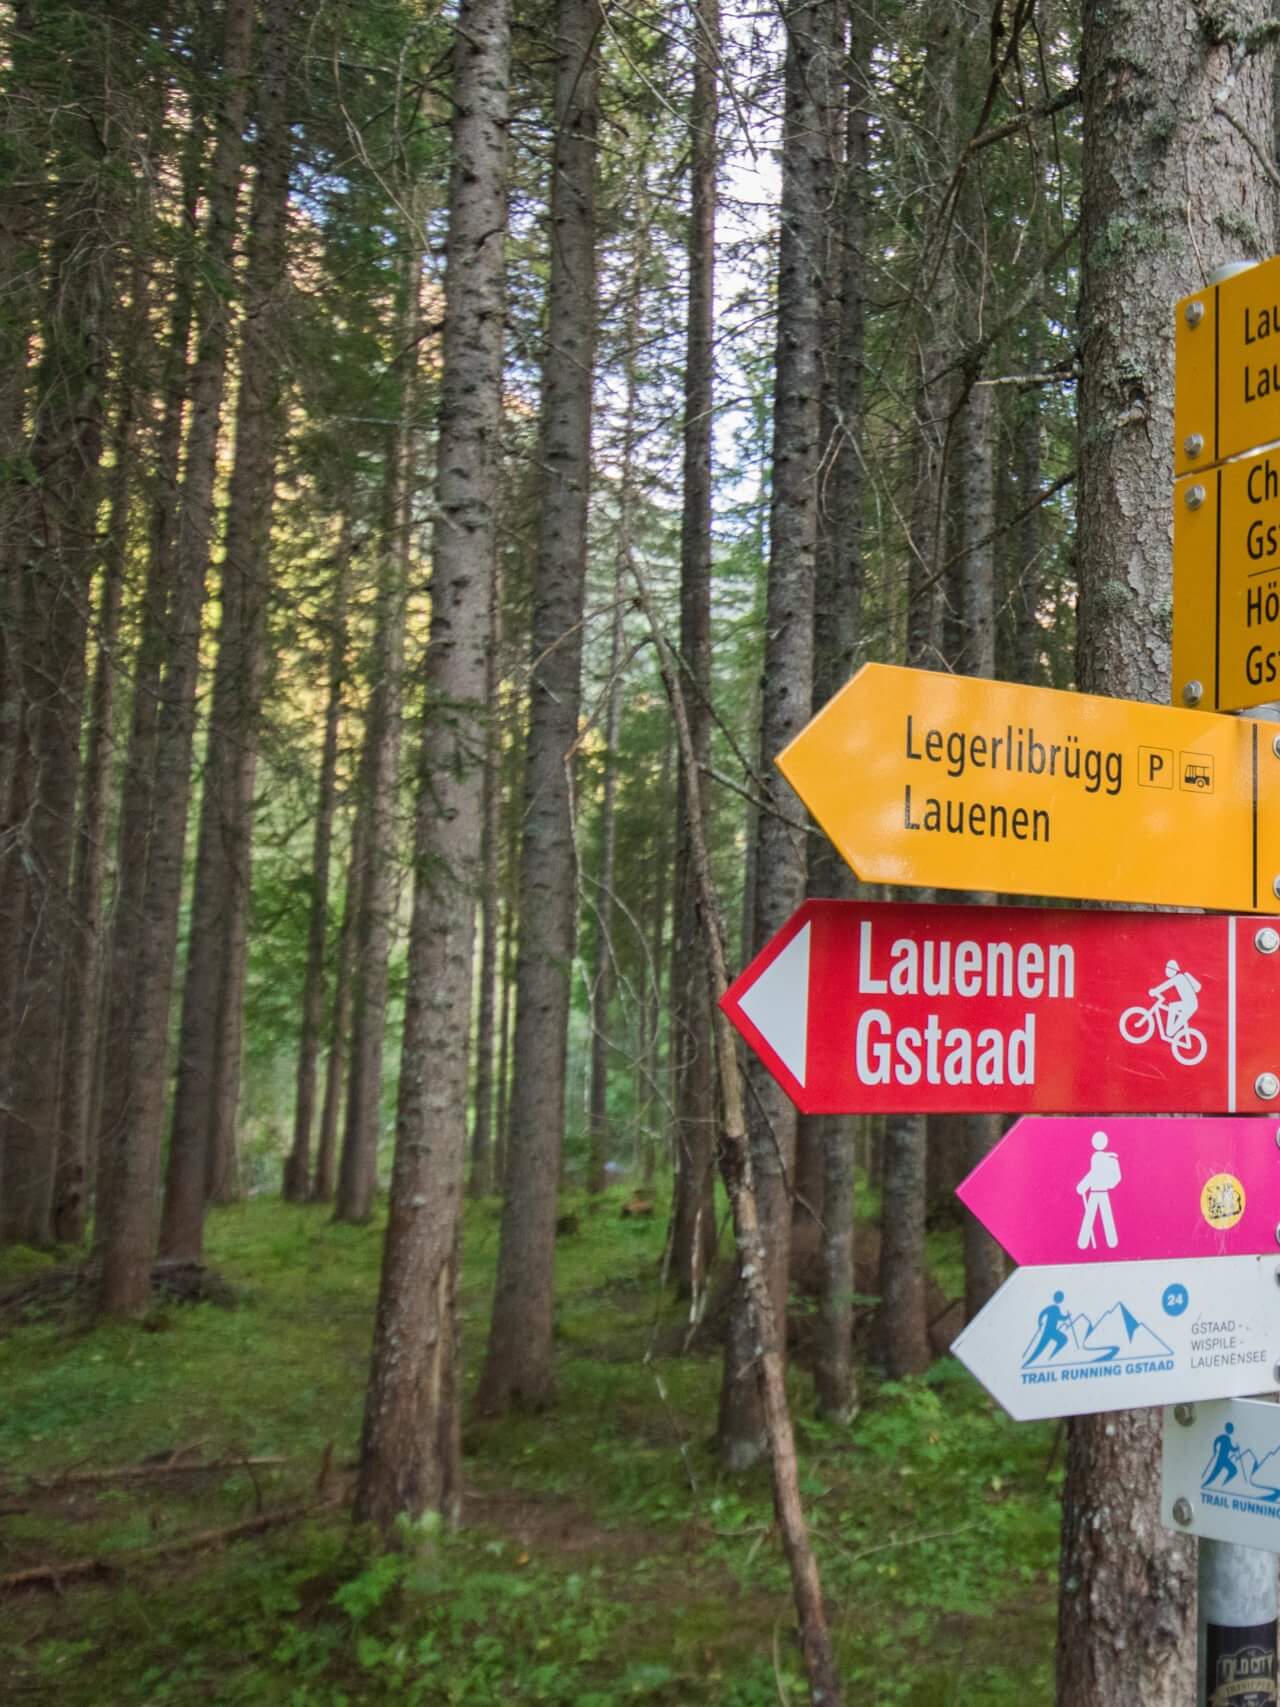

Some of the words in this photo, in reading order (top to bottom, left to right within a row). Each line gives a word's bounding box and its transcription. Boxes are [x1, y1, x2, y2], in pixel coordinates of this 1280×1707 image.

[906, 714, 1124, 796] Legerlibrügg
[904, 785, 1051, 843] Lauenen
[858, 920, 1076, 1000] Lauenen
[855, 1007, 1036, 1086] Gstaad
[1167, 1293, 1184, 1306] 24
[1191, 1320, 1236, 1335] GSTAAD
[1191, 1336, 1237, 1351] WISPILE
[1190, 1350, 1267, 1369] LAUENENSEE
[1021, 1370, 1058, 1385] TRAIL
[1061, 1365, 1122, 1381] RUNNING
[1125, 1359, 1175, 1376] GSTAAD
[1200, 1492, 1229, 1509] TRAIL
